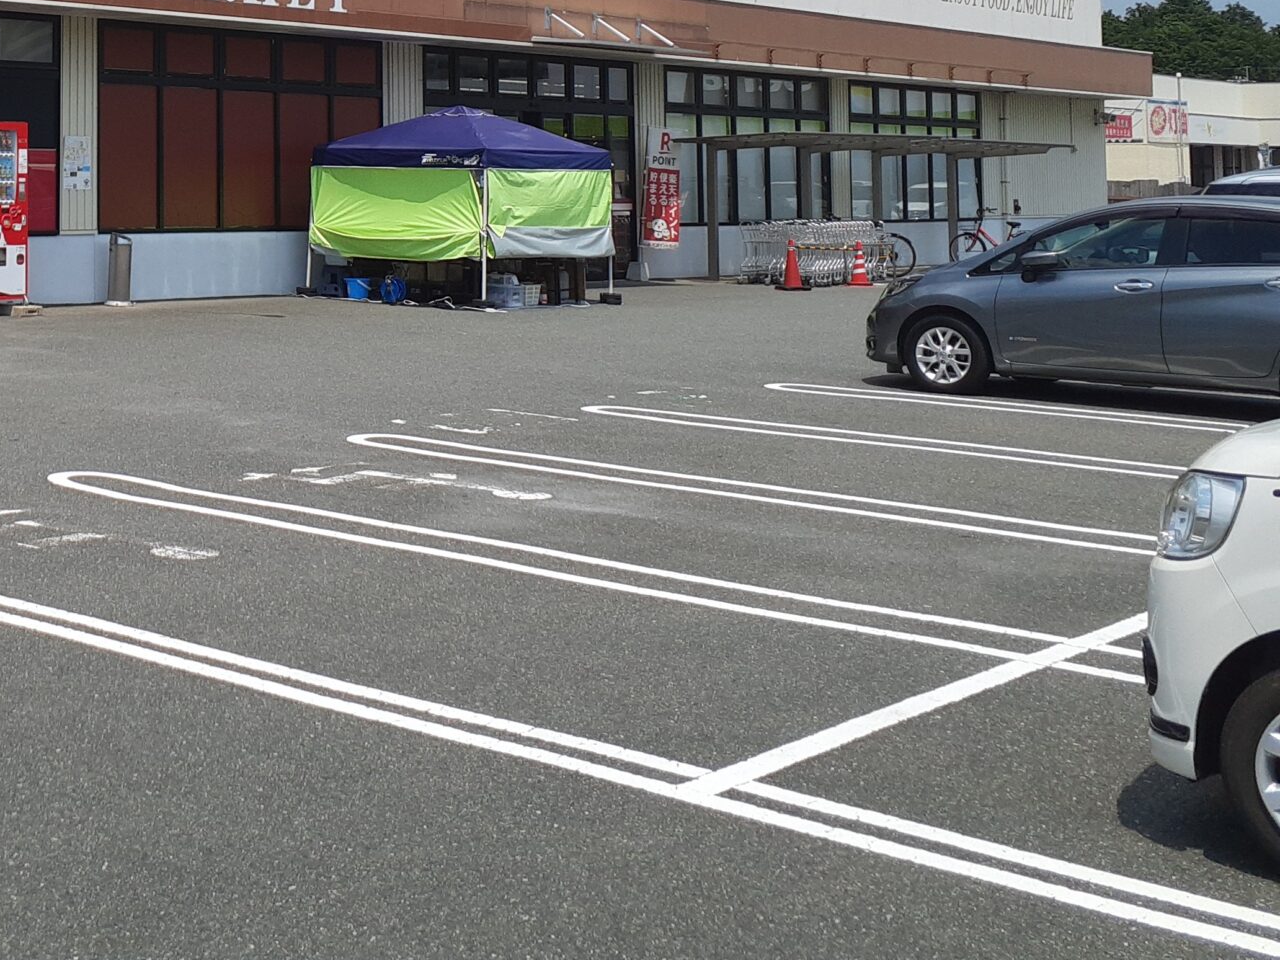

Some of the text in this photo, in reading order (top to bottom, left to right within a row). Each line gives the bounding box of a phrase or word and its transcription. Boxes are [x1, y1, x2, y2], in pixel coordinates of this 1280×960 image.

[652, 156, 677, 166] POINT
[669, 174, 678, 238] 楽天ポイント
